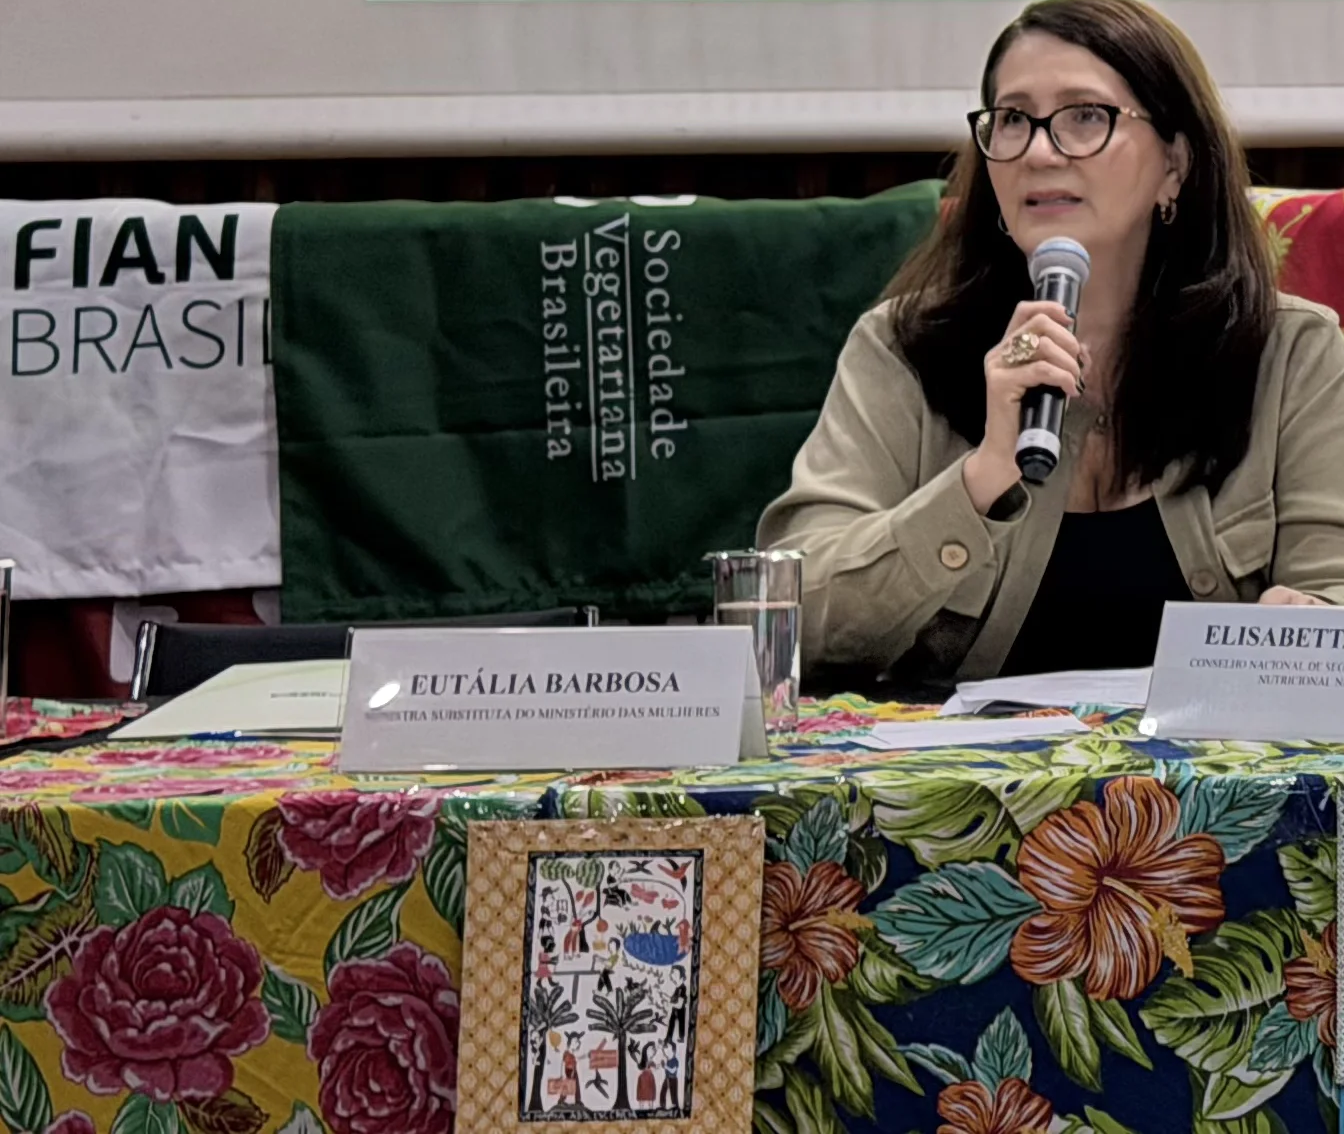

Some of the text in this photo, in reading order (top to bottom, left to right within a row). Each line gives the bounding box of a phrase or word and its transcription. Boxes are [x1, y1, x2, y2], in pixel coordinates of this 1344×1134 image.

[13, 214, 240, 290] FIAN
[540, 239, 583, 460] Brasileira
[582, 213, 629, 481] Vegetariana
[643, 228, 689, 460] Sociedade
[411, 667, 681, 695] EUTÁLIA BARBOSA
[1189, 657, 1248, 670] CONSELHO
[1250, 660, 1306, 672] NACIONAL
[1307, 662, 1323, 673] DE
[1257, 674, 1330, 687] NUTRICIONAL
[430, 708, 512, 722] SUBSTITUTA
[514, 708, 536, 721] DO
[538, 705, 615, 720] MINISTÉRIO
[617, 706, 645, 719] DAS
[647, 705, 721, 718] MULHERES
